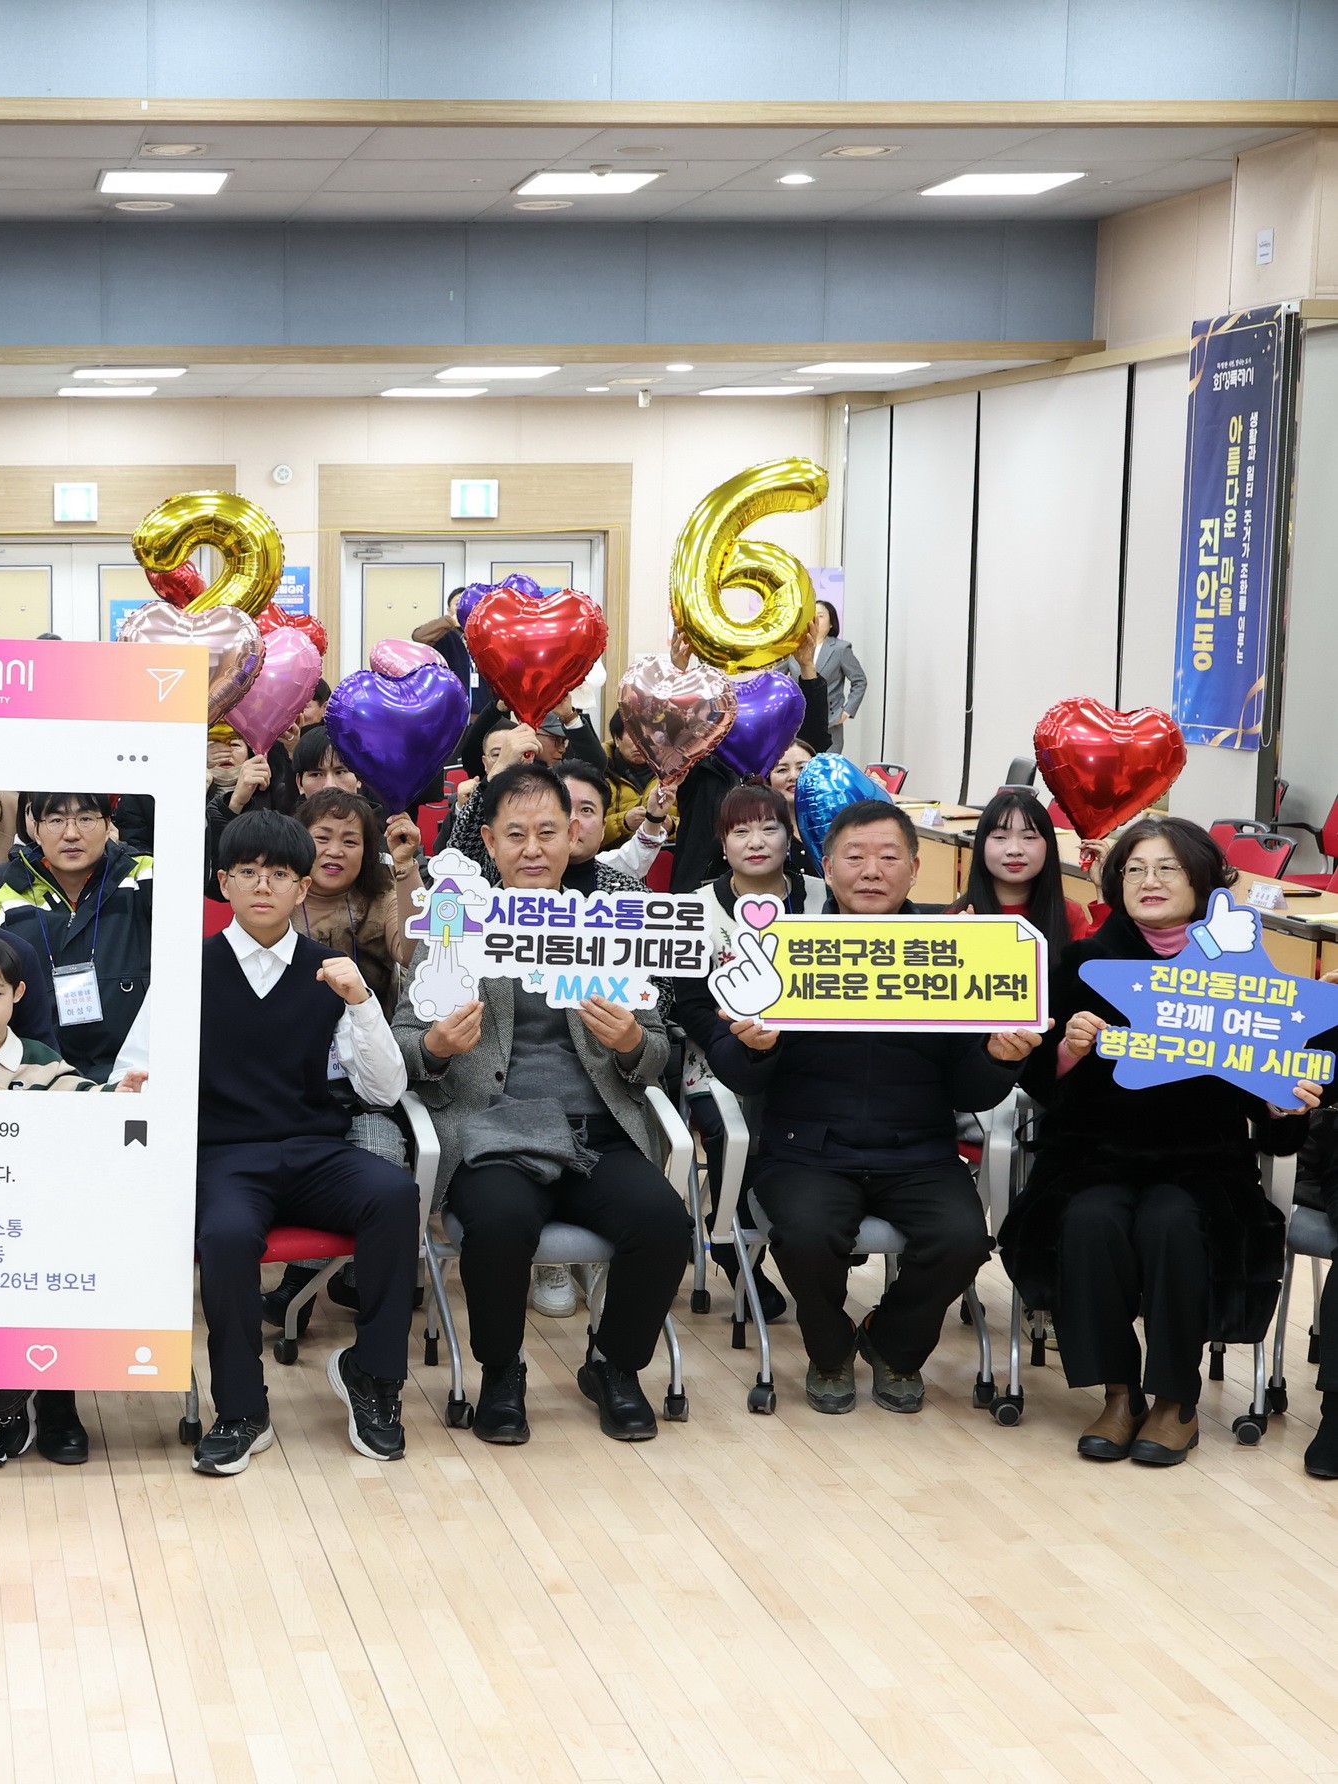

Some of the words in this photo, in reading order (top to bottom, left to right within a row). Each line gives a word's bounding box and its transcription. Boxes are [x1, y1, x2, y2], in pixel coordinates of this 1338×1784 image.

[1212, 366, 1254, 391] 화성특례시
[1247, 410, 1259, 461] 생활과
[1224, 414, 1243, 538] 아름다운
[1242, 509, 1252, 559] 주거가
[1192, 517, 1221, 672] 진안동
[1218, 556, 1235, 616] 마을
[1238, 562, 1249, 612] 조화를
[1236, 616, 1246, 665] 이루는
[484, 895, 577, 928] 시장님
[584, 898, 705, 932] 소통으로
[484, 933, 606, 967] 우리동네
[612, 938, 706, 971] 기대감
[788, 938, 896, 966] 병점구청
[903, 938, 965, 969] 출범,
[554, 974, 630, 1004] MAX
[787, 972, 869, 1000] 새로운
[875, 973, 958, 1001] 도약의
[964, 973, 1028, 1002] 시작!
[1149, 965, 1298, 1007] 진안동민과
[1156, 1000, 1215, 1033] 함께
[1222, 1008, 1282, 1041] 여는
[1099, 1028, 1216, 1068] 병점구의
[1222, 1043, 1255, 1073] 새
[1259, 1048, 1333, 1083] 시대!
[46, 1272, 96, 1292] 병오년
